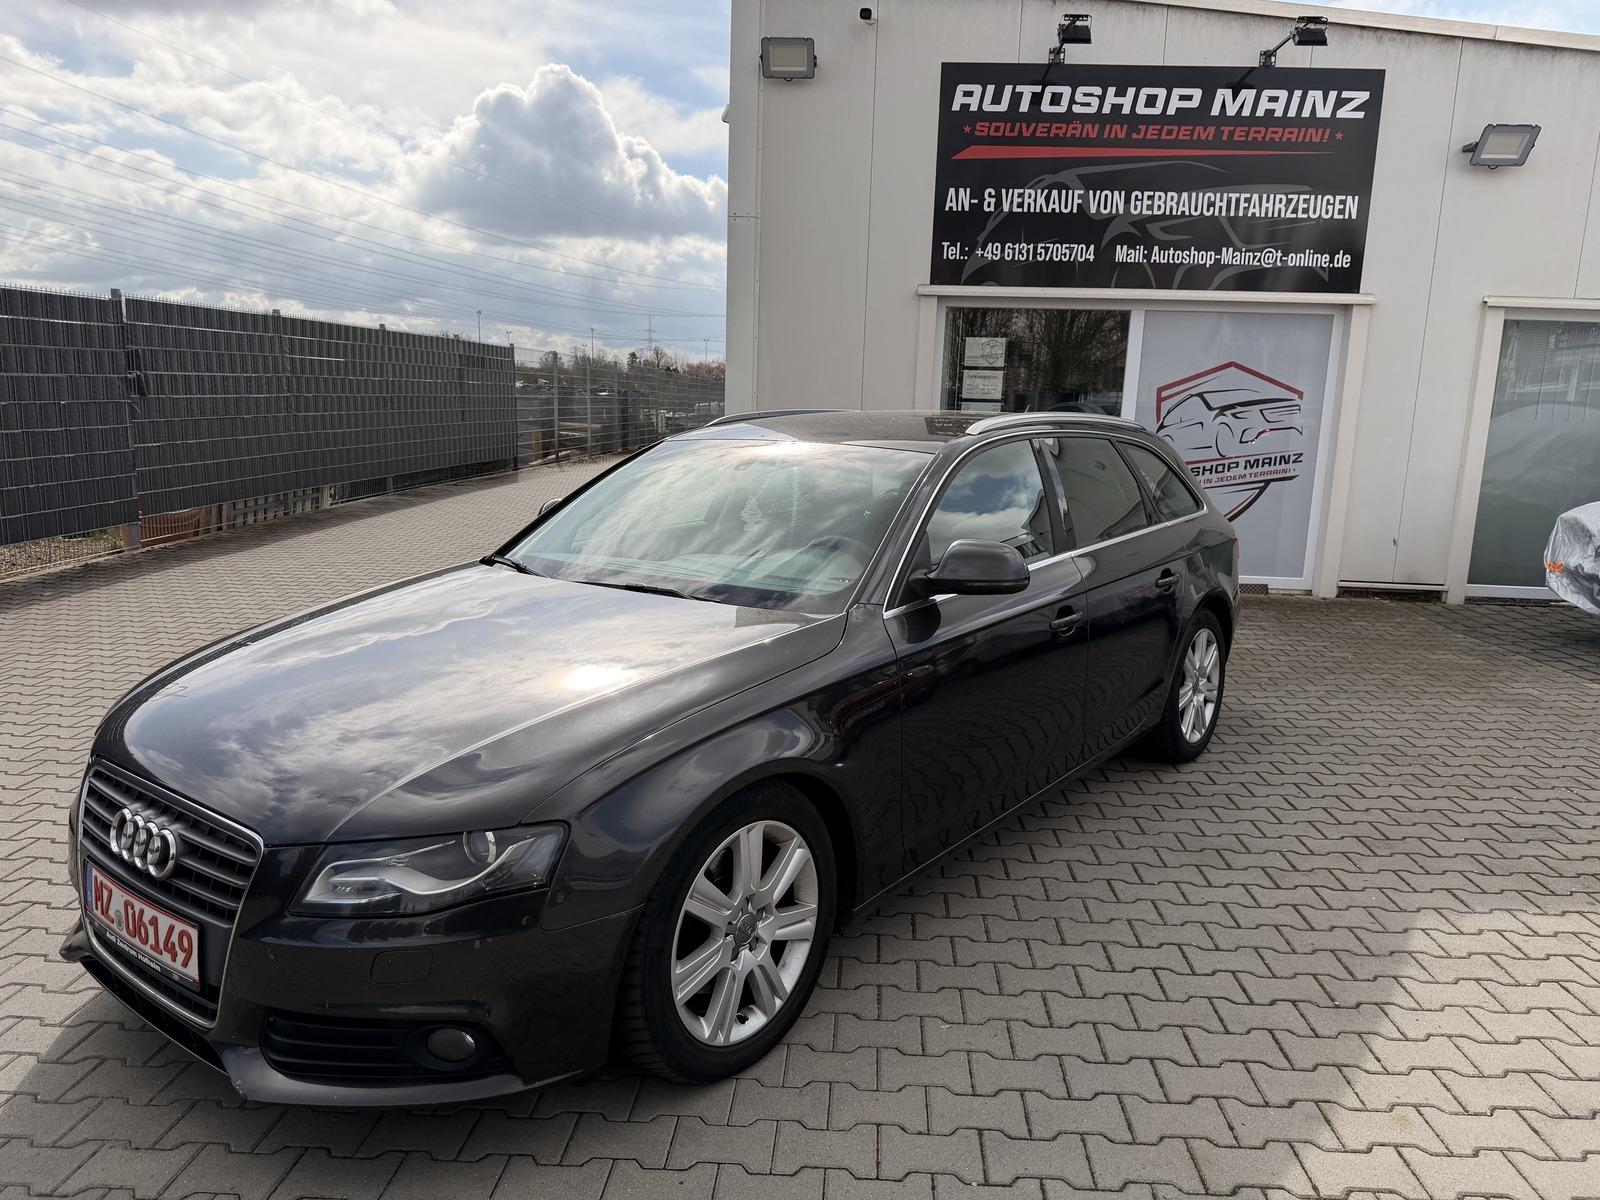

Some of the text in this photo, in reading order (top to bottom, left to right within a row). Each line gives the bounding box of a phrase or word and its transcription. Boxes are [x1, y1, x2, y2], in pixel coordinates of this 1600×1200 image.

[951, 84, 1370, 119] AUTOSHOP MAINZ
[974, 120, 1331, 142] SOUVERÄN IN JEDEM TERRAIN!
[944, 187, 1359, 220] AN- & VERKAUF VON GEBRAUCHTFAHRZEUGEN
[941, 241, 1096, 262] Tel.: +49 6131 5705704
[1115, 245, 1351, 268] Mail: Autoshop-Mainz@t-online.de
[1243, 452, 1304, 471] MAINZ
[1214, 473, 1247, 483] JEDEM
[1248, 468, 1291, 478] TERRAIN!
[93, 874, 194, 969] MZ 06149
